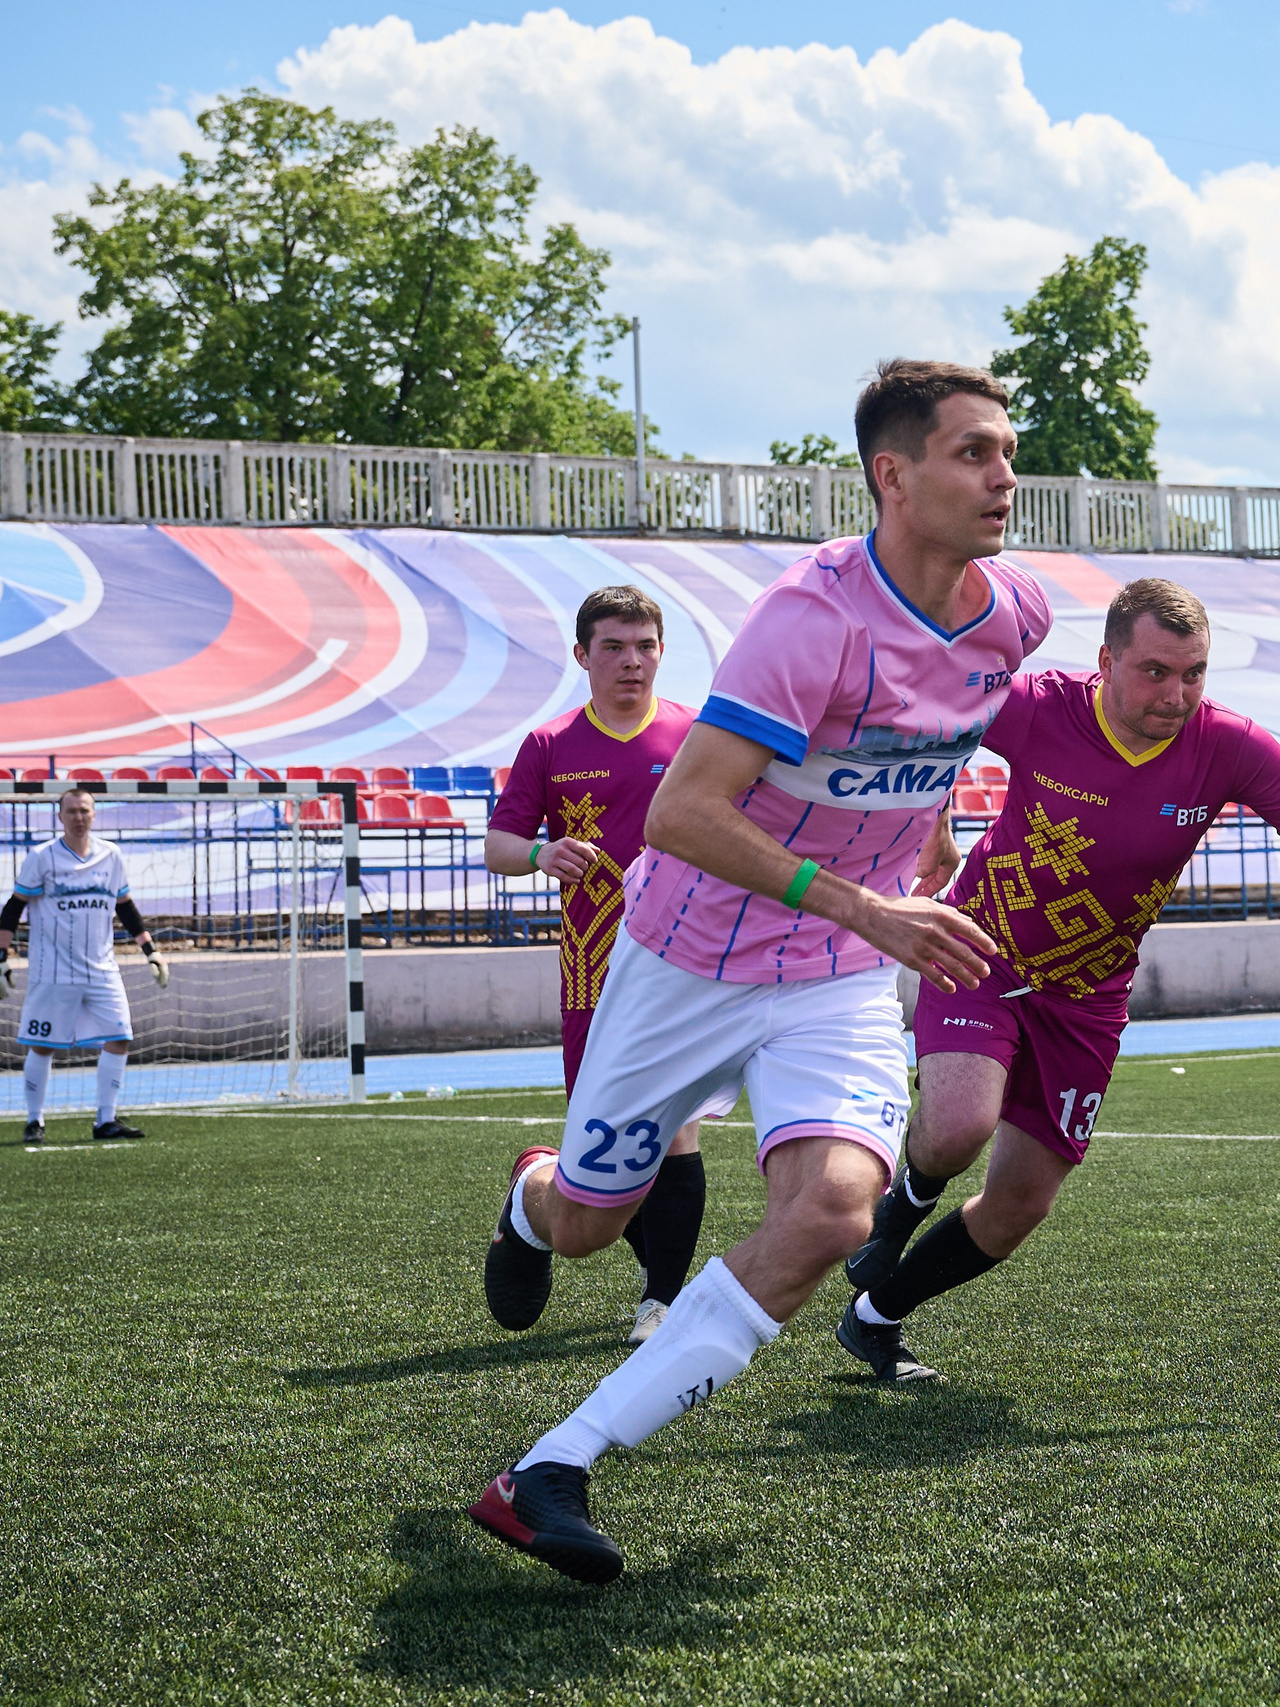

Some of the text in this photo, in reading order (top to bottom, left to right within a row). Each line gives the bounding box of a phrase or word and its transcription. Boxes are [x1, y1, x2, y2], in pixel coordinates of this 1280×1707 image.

[551, 769, 610, 783] ЧЕБОКСАРЫ
[1033, 770, 1109, 807] ЧЕБОКСАРЫ
[1176, 805, 1209, 826] ВТБ
[28, 1019, 52, 1037] 89
[968, 1019, 994, 1030] SPORT
[1060, 1087, 1102, 1141] 13
[577, 1118, 662, 1174] 23
